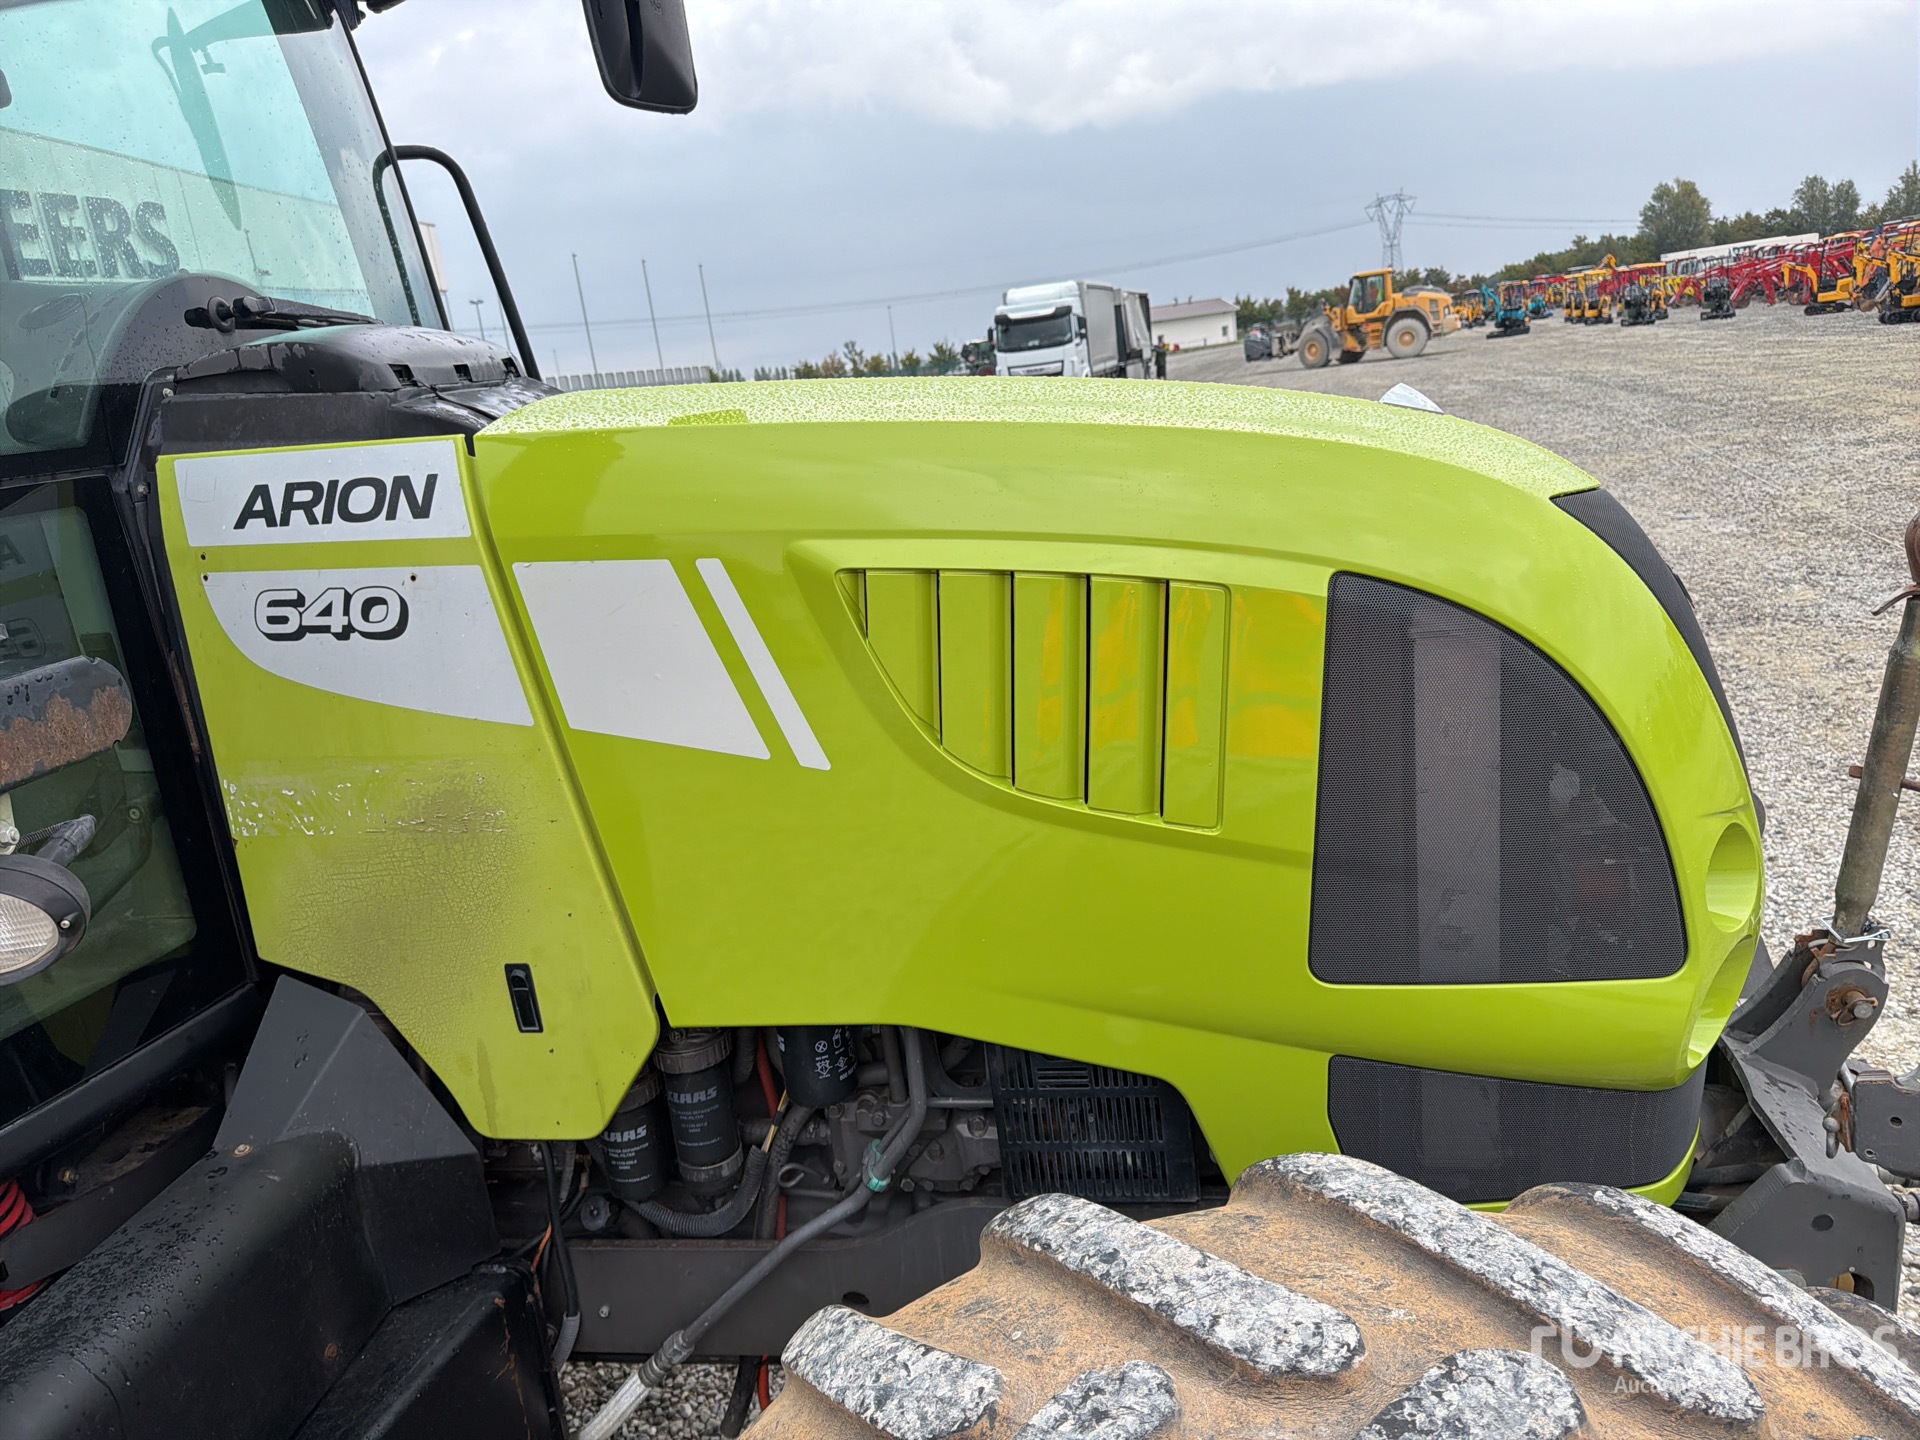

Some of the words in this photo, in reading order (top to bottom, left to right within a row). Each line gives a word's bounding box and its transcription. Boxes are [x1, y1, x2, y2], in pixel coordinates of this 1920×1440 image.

[233, 473, 438, 530] ARION
[254, 585, 409, 641] 640
[601, 1124, 648, 1143] LAAS
